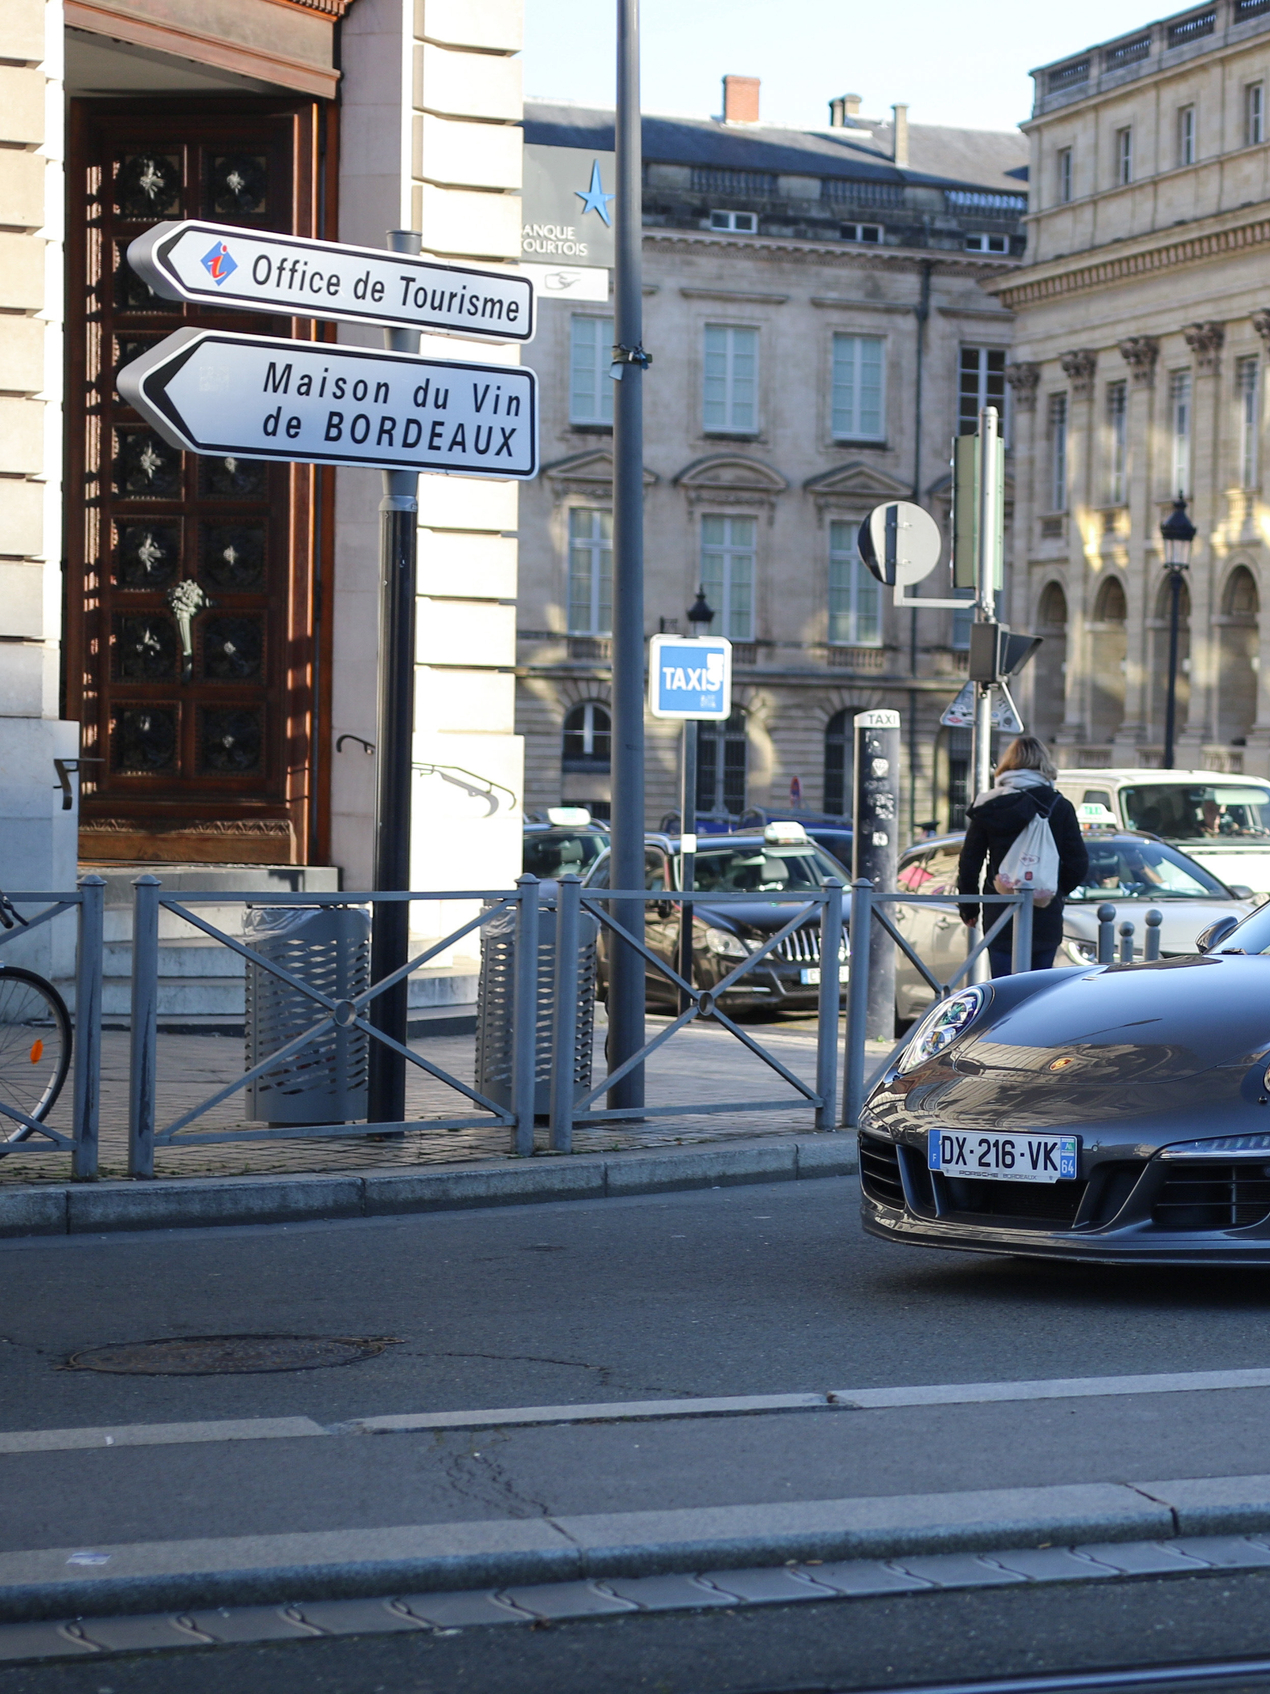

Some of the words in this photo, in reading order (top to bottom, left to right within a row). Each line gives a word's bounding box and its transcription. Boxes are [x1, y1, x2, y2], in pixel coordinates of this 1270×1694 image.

[522, 224, 576, 240] ANQUE
[521, 238, 588, 256] OURTOIS
[252, 254, 341, 296] Office
[353, 270, 385, 303] de
[400, 275, 519, 322] Tourisme
[263, 361, 390, 404] Maison
[413, 378, 449, 410] du
[473, 382, 521, 417] Vin
[262, 405, 302, 439] de
[323, 411, 517, 458] BORDEAUX
[867, 714, 896, 725] TAXI
[941, 1135, 1059, 1172] DX-216-VK
[958, 1170, 999, 1179] PORSCHE
[1002, 1172, 1038, 1181] BORDEAUX
[1061, 1159, 1075, 1175] 64
